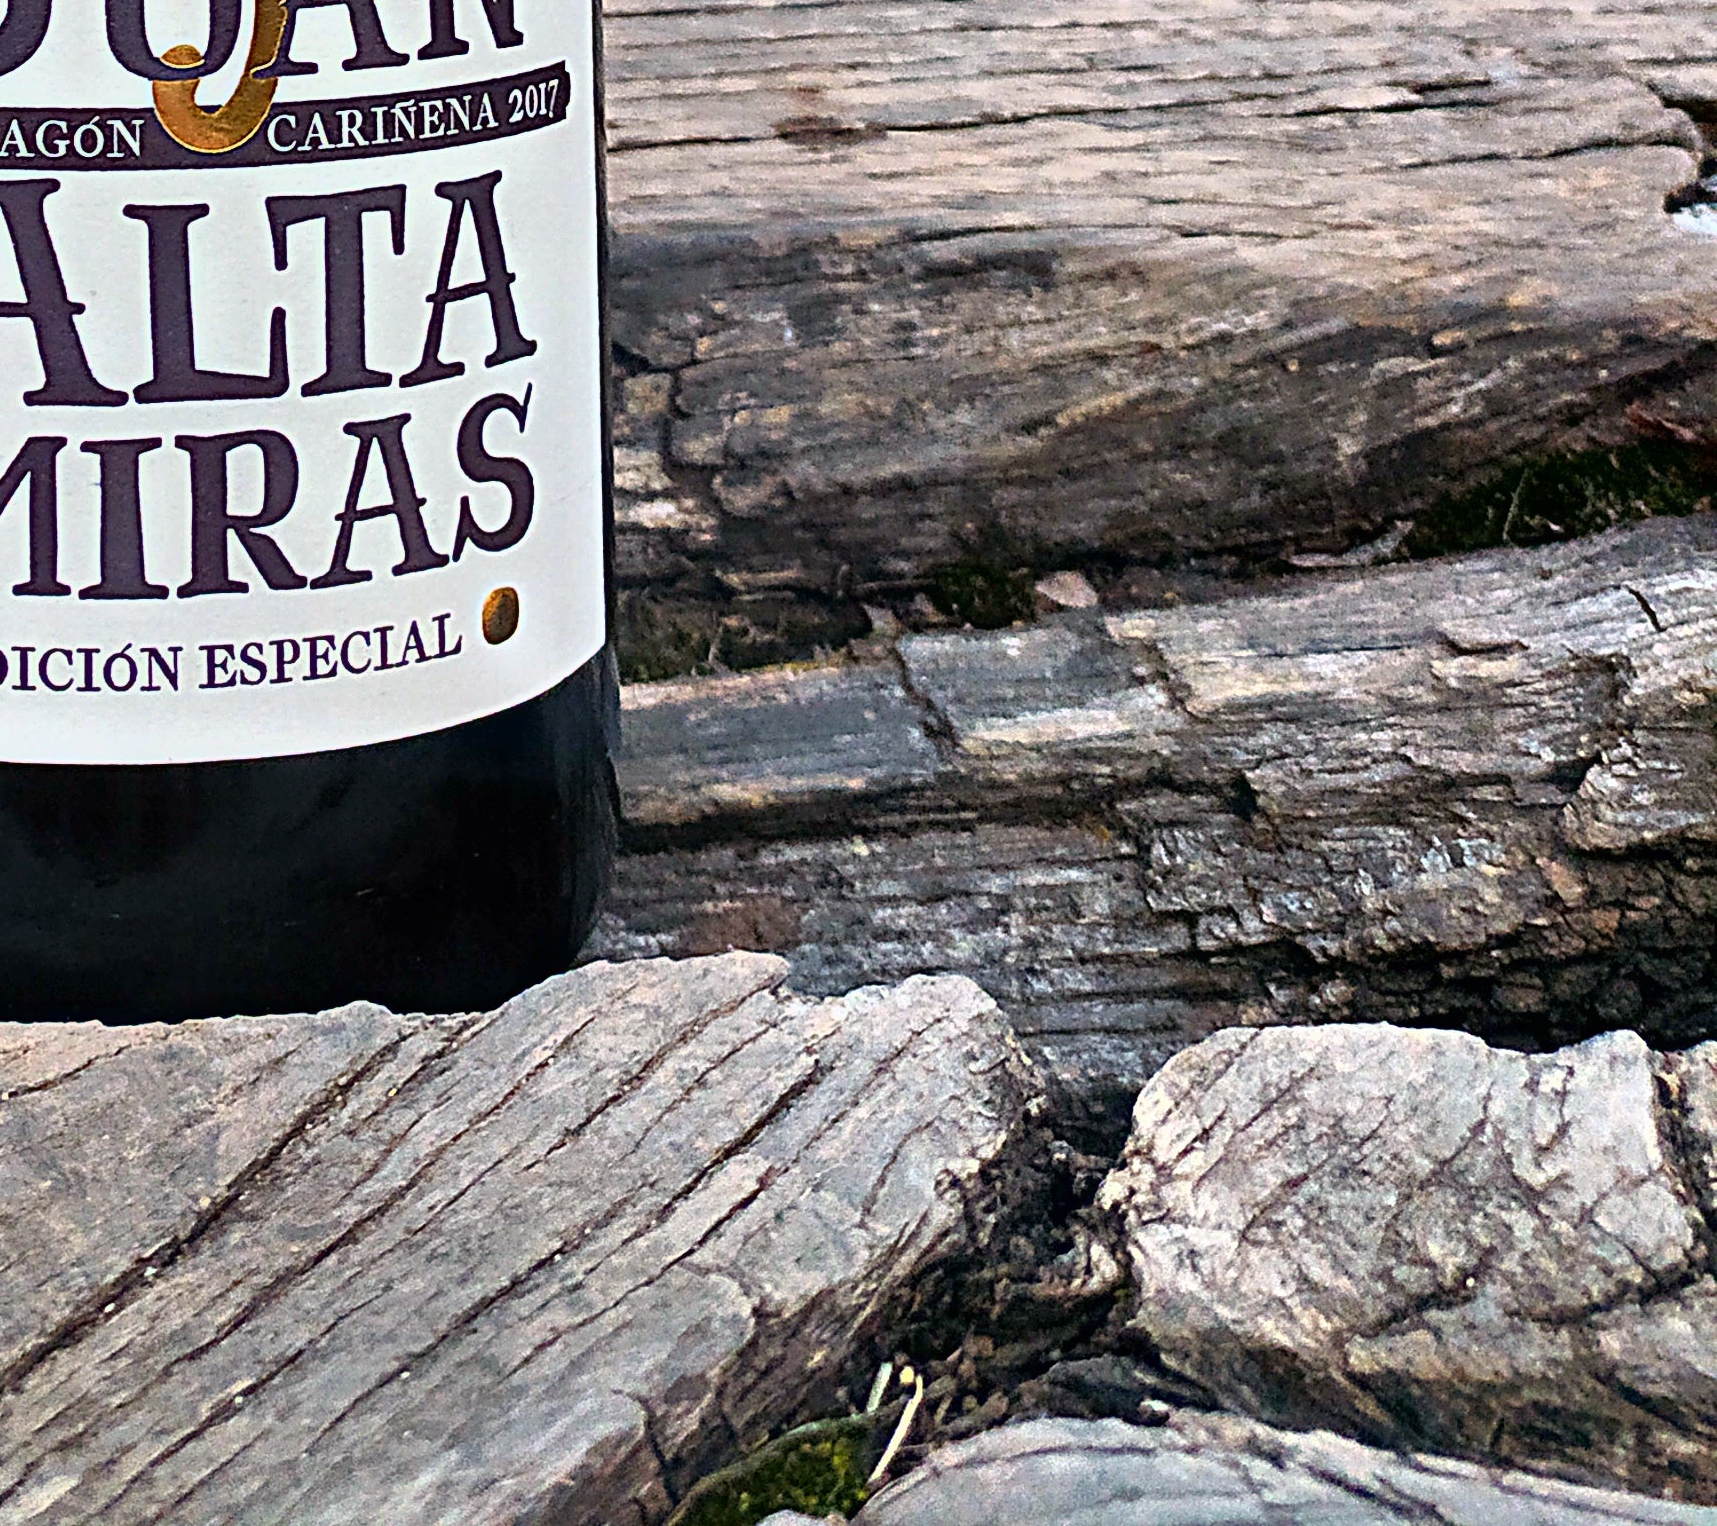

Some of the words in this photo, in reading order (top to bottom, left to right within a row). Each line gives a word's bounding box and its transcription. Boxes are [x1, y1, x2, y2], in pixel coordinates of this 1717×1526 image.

[266, 96, 500, 153] CARIÑENA
[508, 77, 561, 125] 2017
[197, 611, 464, 691] ESPECIAL
